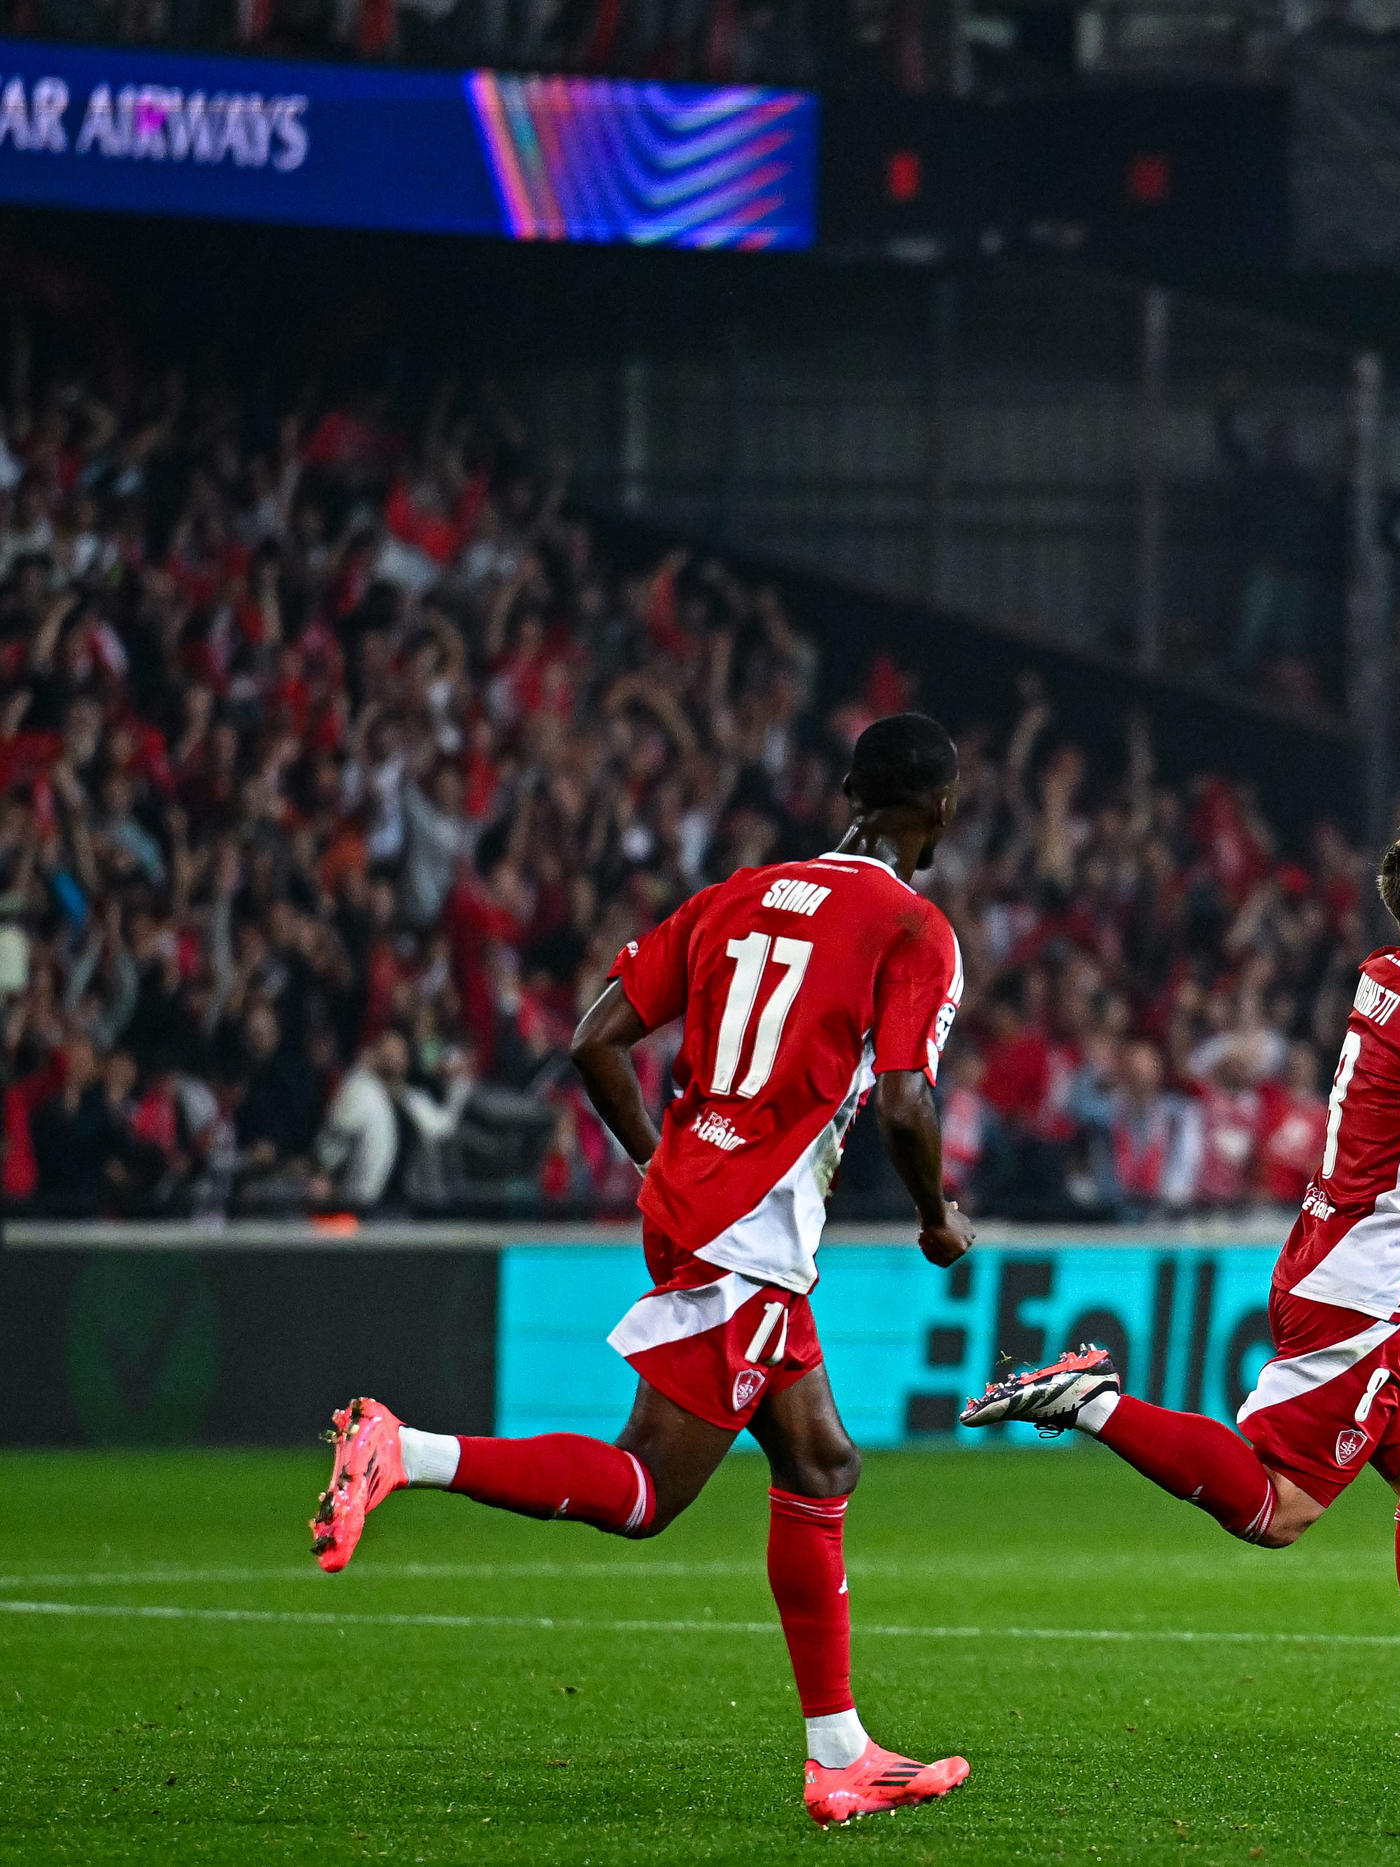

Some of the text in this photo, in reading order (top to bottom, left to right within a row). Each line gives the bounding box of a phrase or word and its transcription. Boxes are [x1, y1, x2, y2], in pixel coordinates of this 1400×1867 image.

[75, 83, 309, 173] AIRWAYS
[761, 878, 833, 917] SIMA
[710, 931, 814, 1099] 17
[1354, 1367, 1390, 1422] 8
